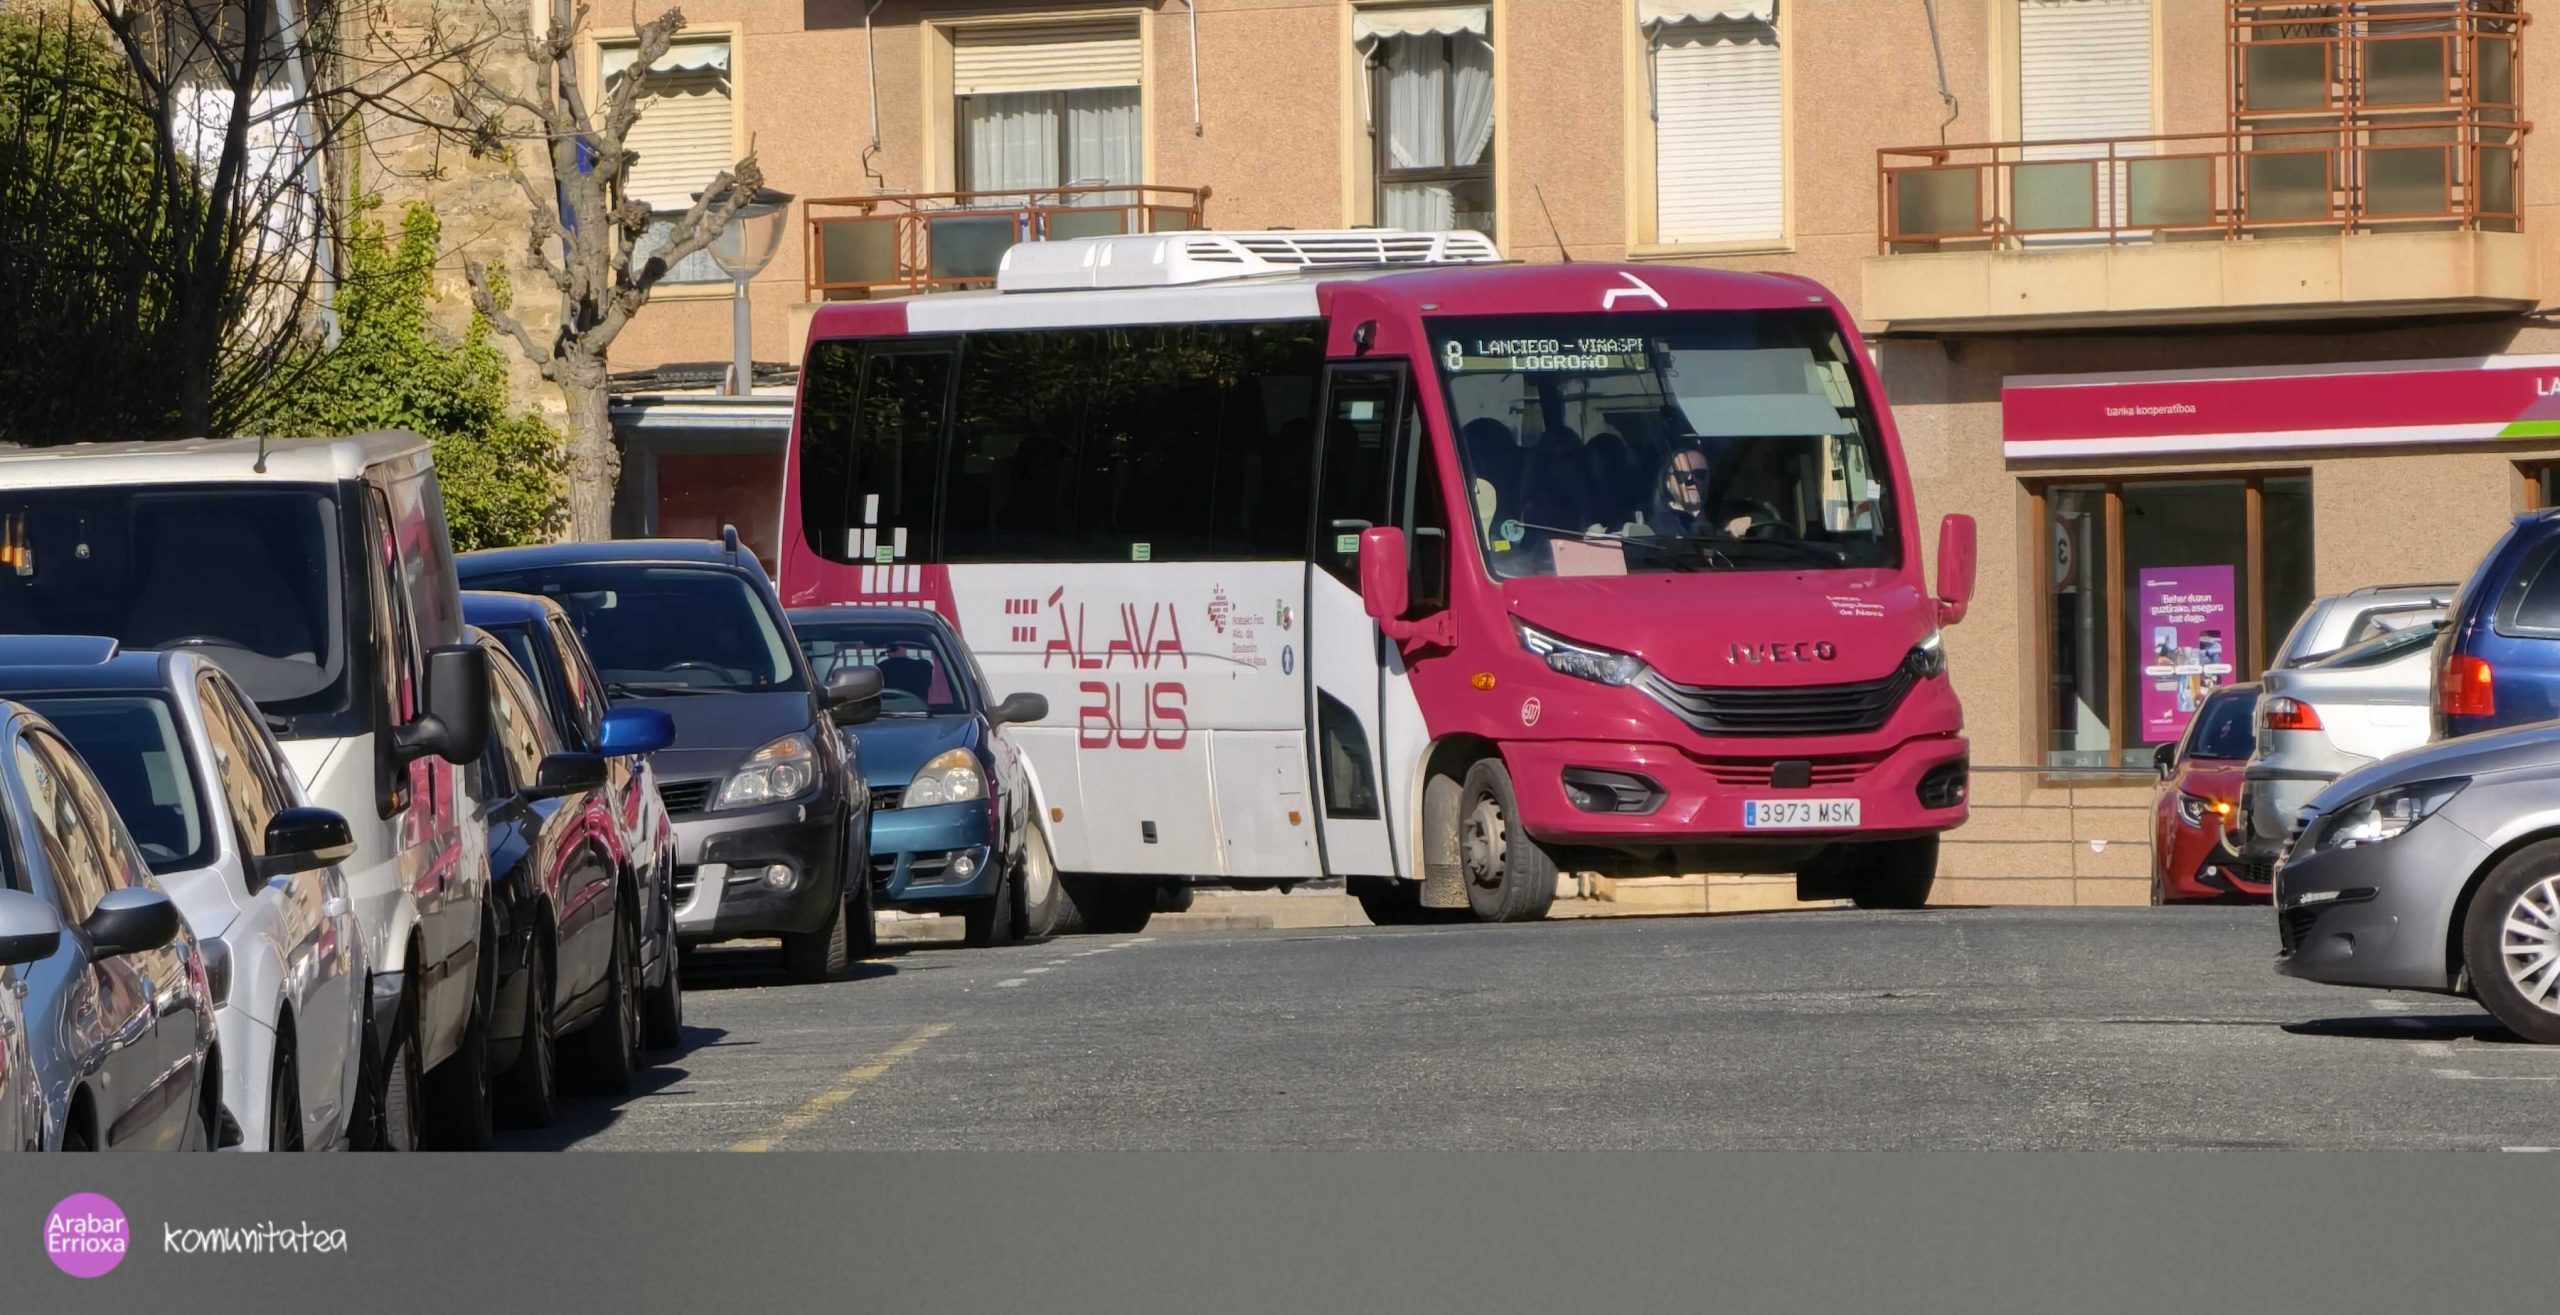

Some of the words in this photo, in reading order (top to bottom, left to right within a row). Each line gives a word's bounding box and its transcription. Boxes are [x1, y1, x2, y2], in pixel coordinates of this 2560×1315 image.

[1447, 340, 1463, 370] 8
[1479, 339, 1559, 355] LANCIEGO
[1512, 354, 1608, 370] LOGROÑO
[1044, 585, 1188, 669] ÁLAVA
[1727, 641, 1837, 664] IVECO
[1079, 681, 1189, 750] BUS
[1760, 803, 1811, 823] 3973
[1819, 802, 1855, 823] MSK
